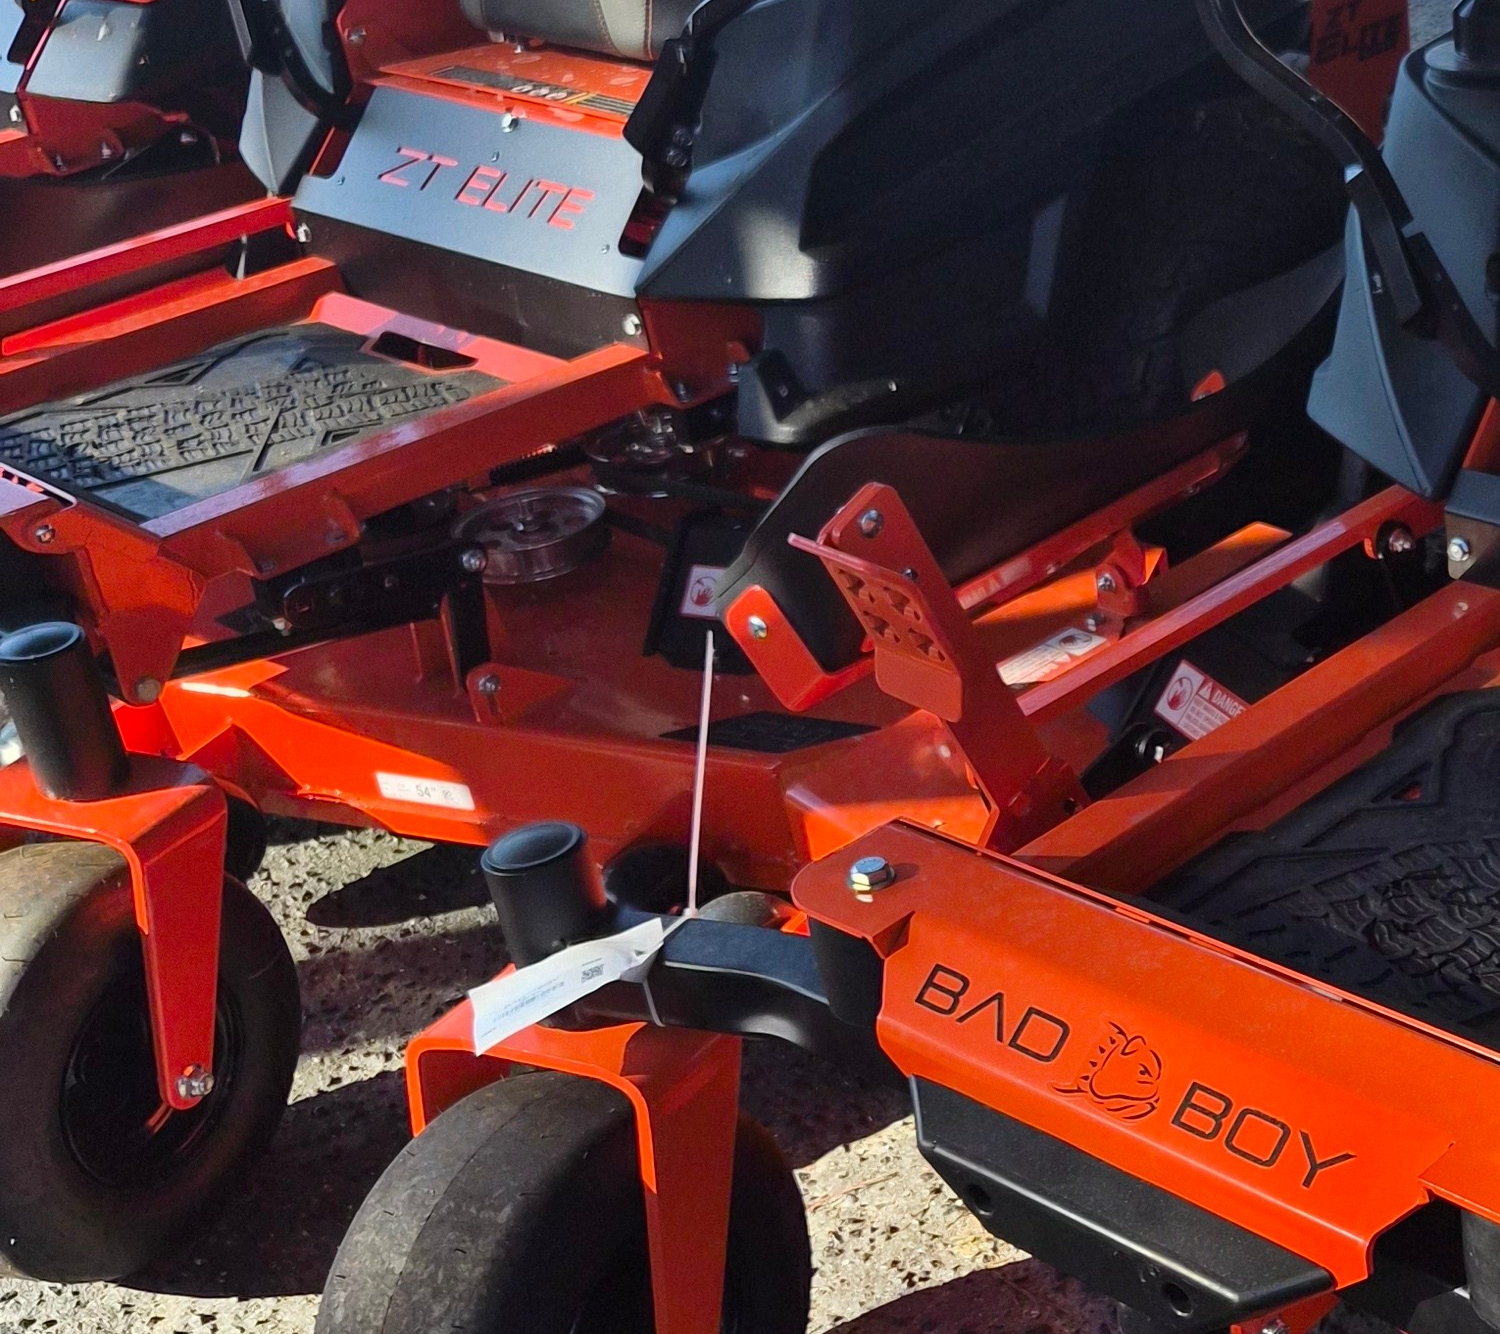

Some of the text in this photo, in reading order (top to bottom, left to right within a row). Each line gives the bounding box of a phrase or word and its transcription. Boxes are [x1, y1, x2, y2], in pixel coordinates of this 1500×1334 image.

[378, 146, 596, 231] ZT ELITE
[1211, 690, 1247, 718] DANGE
[914, 963, 1358, 1188] BAD BOY
